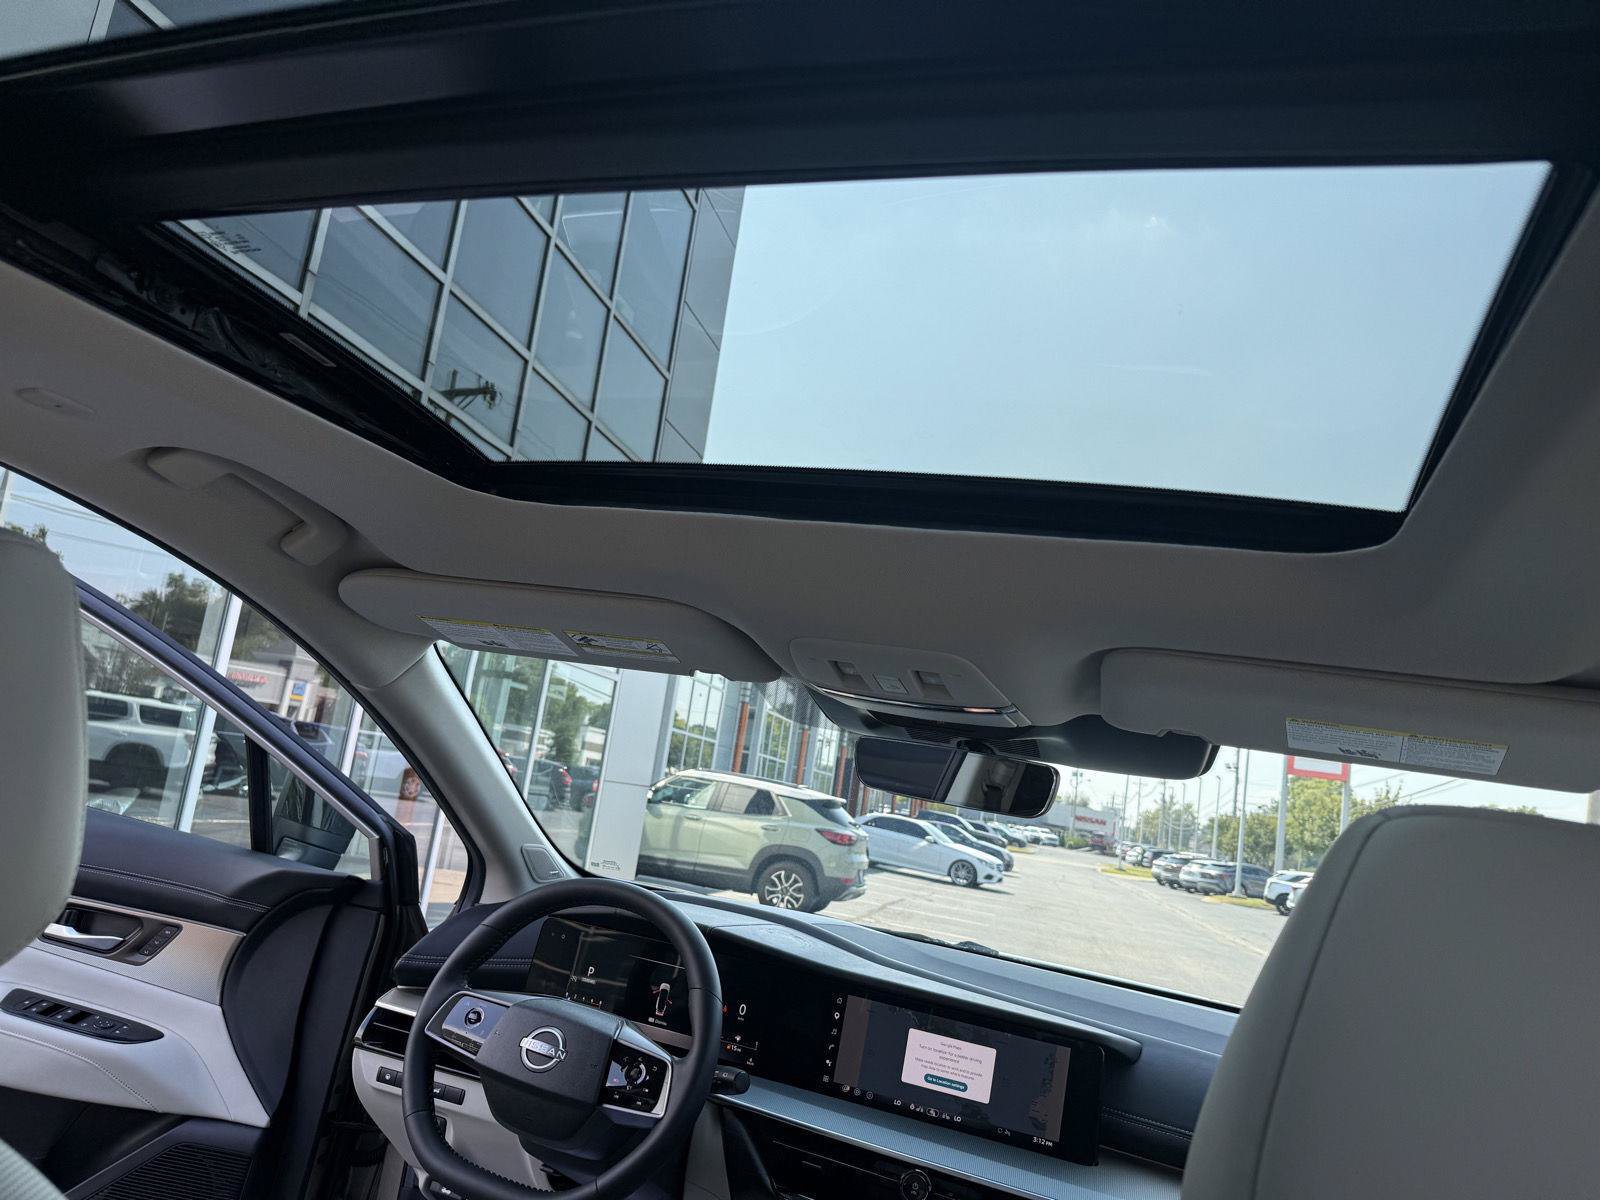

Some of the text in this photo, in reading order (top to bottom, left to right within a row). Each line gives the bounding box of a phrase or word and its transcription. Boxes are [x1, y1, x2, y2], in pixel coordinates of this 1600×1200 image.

[1074, 815, 1106, 826] NISSAN
[587, 966, 595, 977] P
[739, 1004, 747, 1015] 0
[521, 1038, 567, 1060] NISSAN
